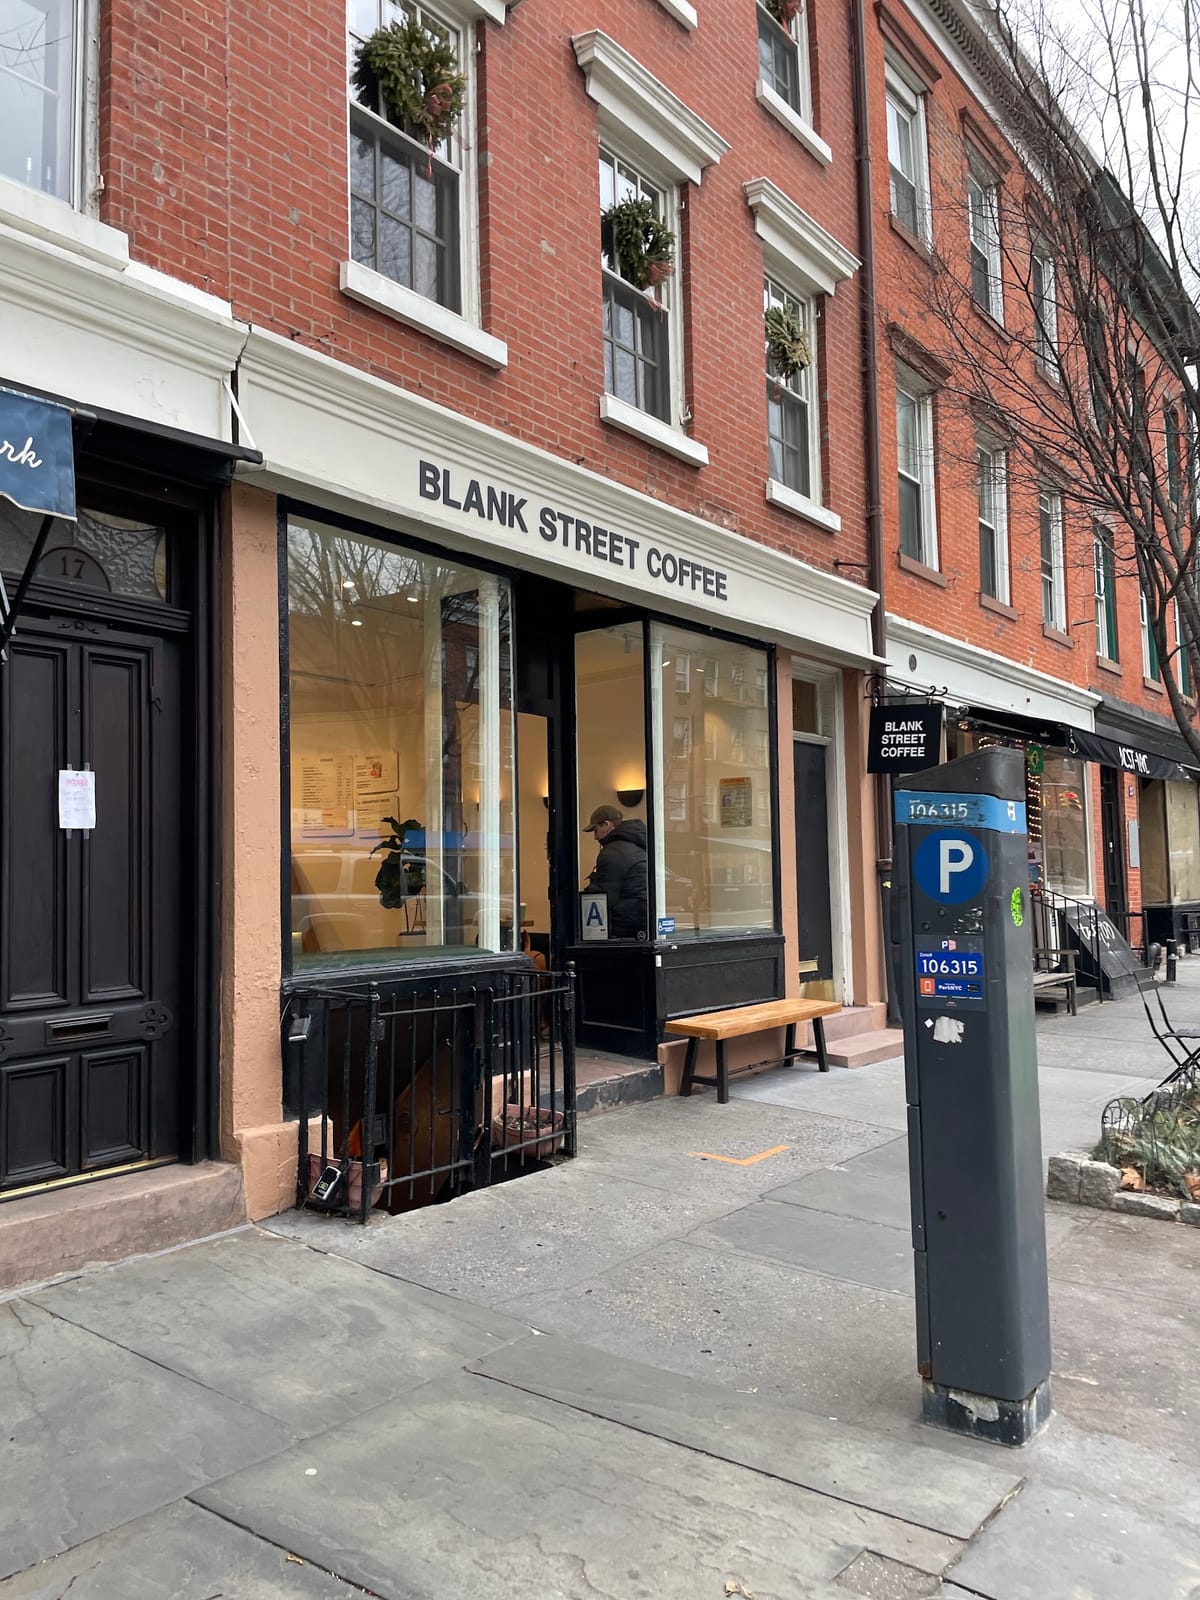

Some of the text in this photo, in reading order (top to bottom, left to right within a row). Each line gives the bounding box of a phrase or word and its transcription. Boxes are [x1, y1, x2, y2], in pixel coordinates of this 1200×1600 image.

[419, 459, 728, 601] BLANK STREET COFFEE
[60, 555, 86, 579] 17
[884, 720, 924, 732] BLANK
[881, 733, 927, 745] STREET
[880, 746, 926, 758] COFFEE
[909, 803, 968, 819] 106315
[940, 839, 974, 893] P
[586, 901, 604, 927] A
[922, 959, 978, 975] 106315
